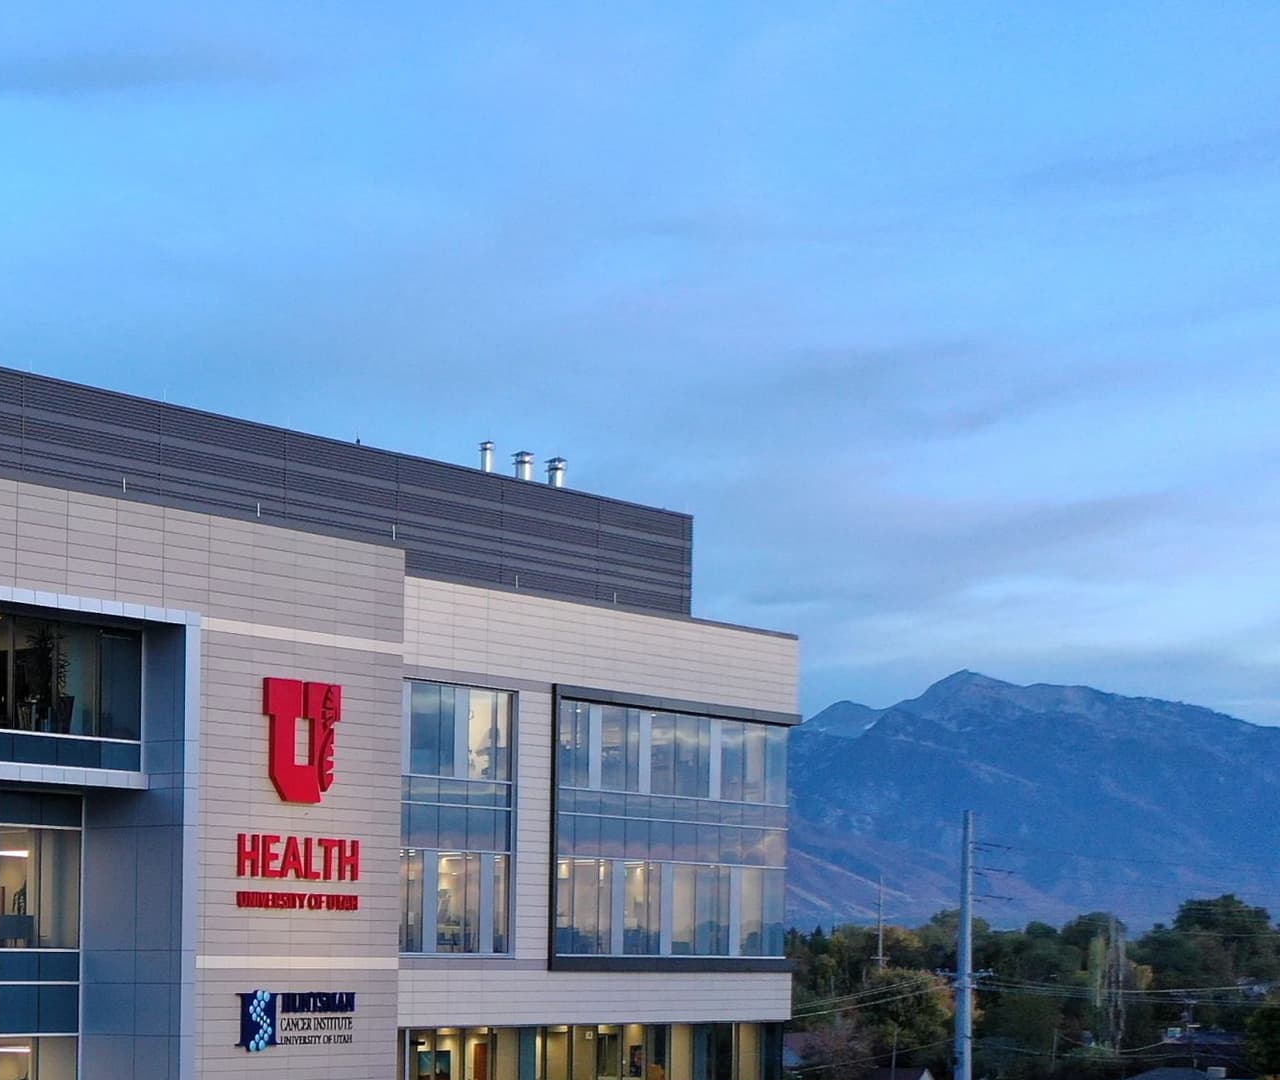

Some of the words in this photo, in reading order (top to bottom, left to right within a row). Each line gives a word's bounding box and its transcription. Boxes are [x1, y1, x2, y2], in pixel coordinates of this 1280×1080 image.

[262, 677, 342, 804] U
[237, 833, 359, 881] HEALTH
[237, 891, 307, 909] UNIVERSITY
[307, 893, 326, 910] OF
[326, 894, 358, 910] UTAH
[280, 1017, 313, 1031] CANCER
[314, 1016, 353, 1030] INSTITUTE
[280, 1035, 320, 1045] UNIVERSITY
[321, 1034, 331, 1044] OF
[331, 1033, 353, 1044] UTAH
